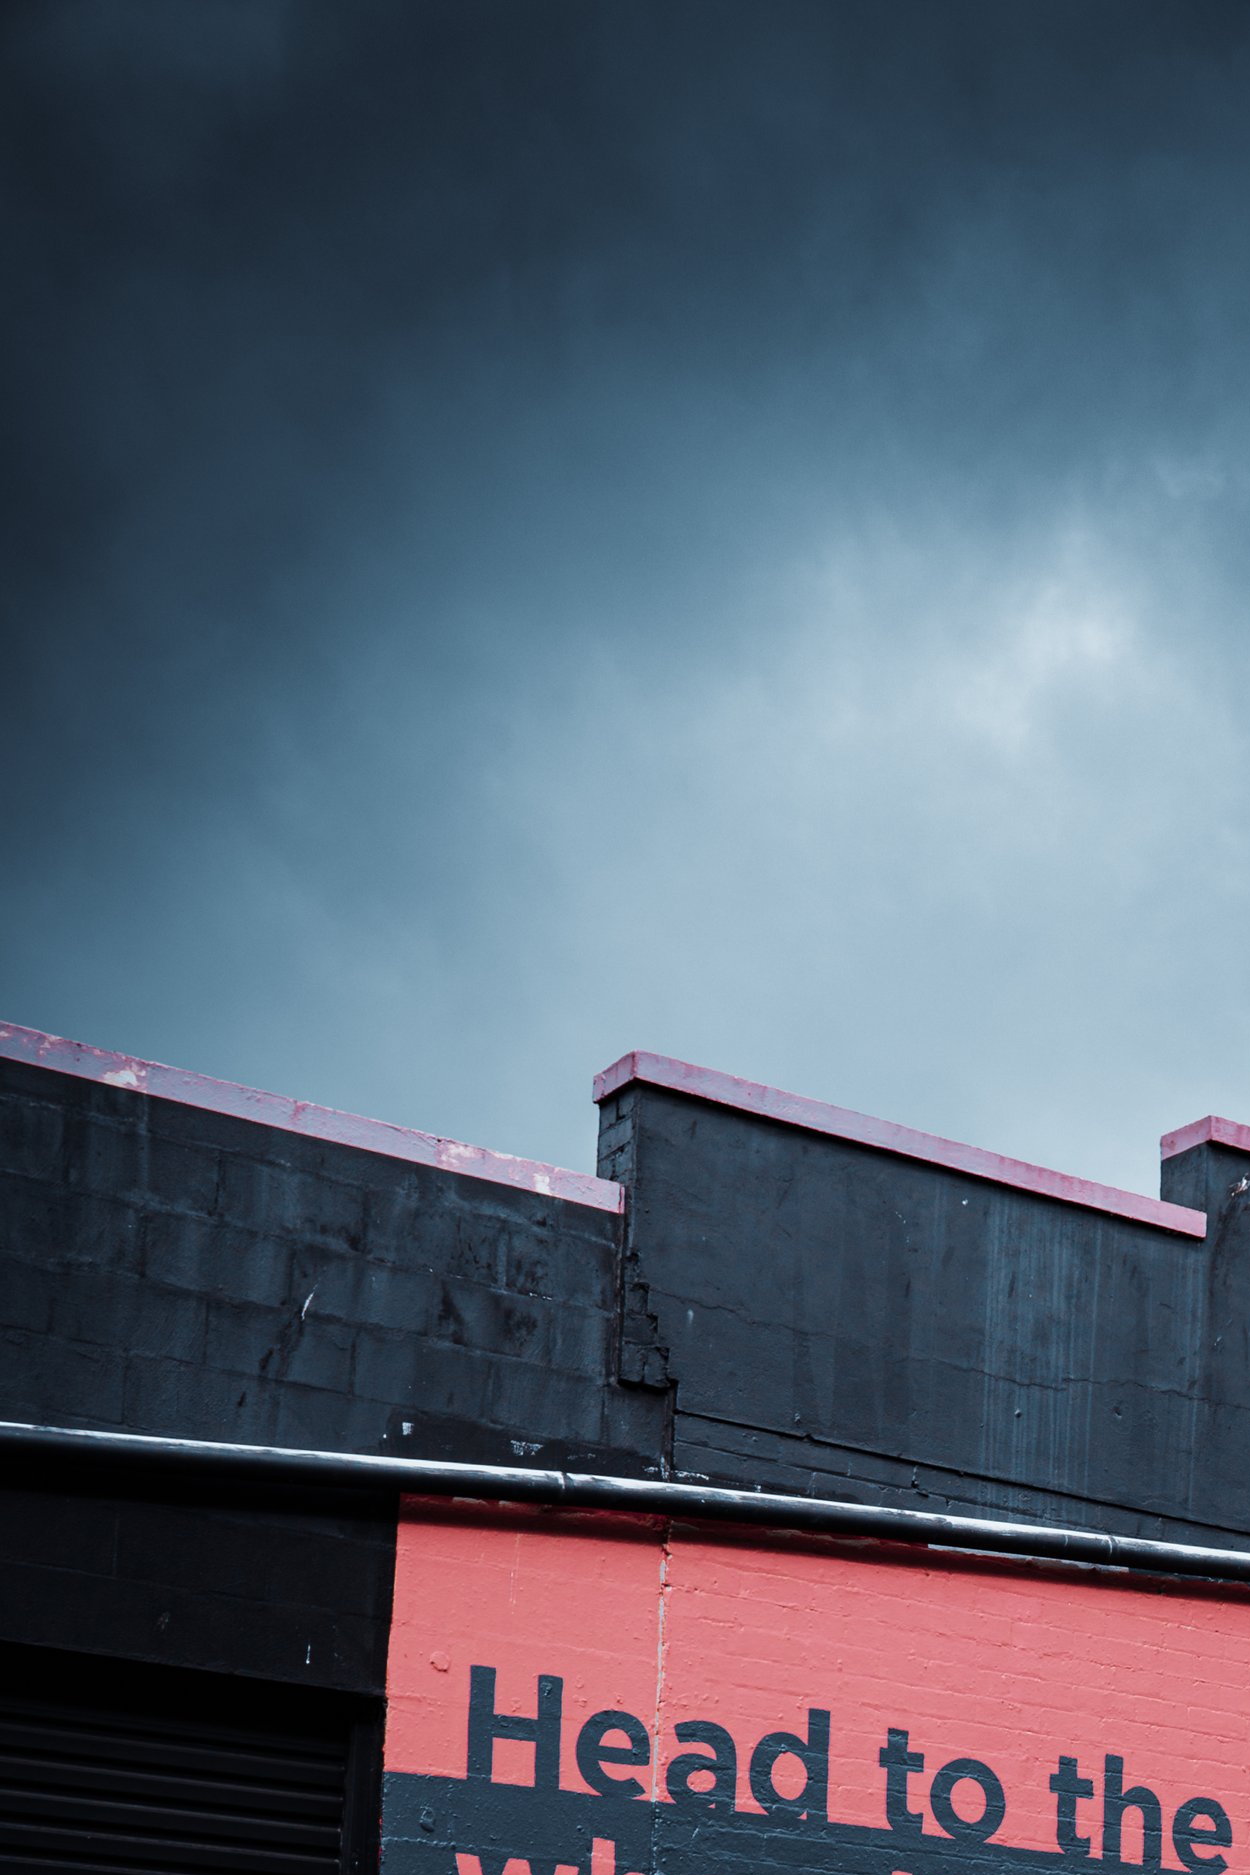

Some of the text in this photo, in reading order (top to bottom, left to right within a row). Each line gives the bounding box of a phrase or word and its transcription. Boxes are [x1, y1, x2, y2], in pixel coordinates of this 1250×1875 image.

[467, 1665, 831, 1822] Head
[880, 1728, 1006, 1842] to
[1049, 1754, 1233, 1875] the
